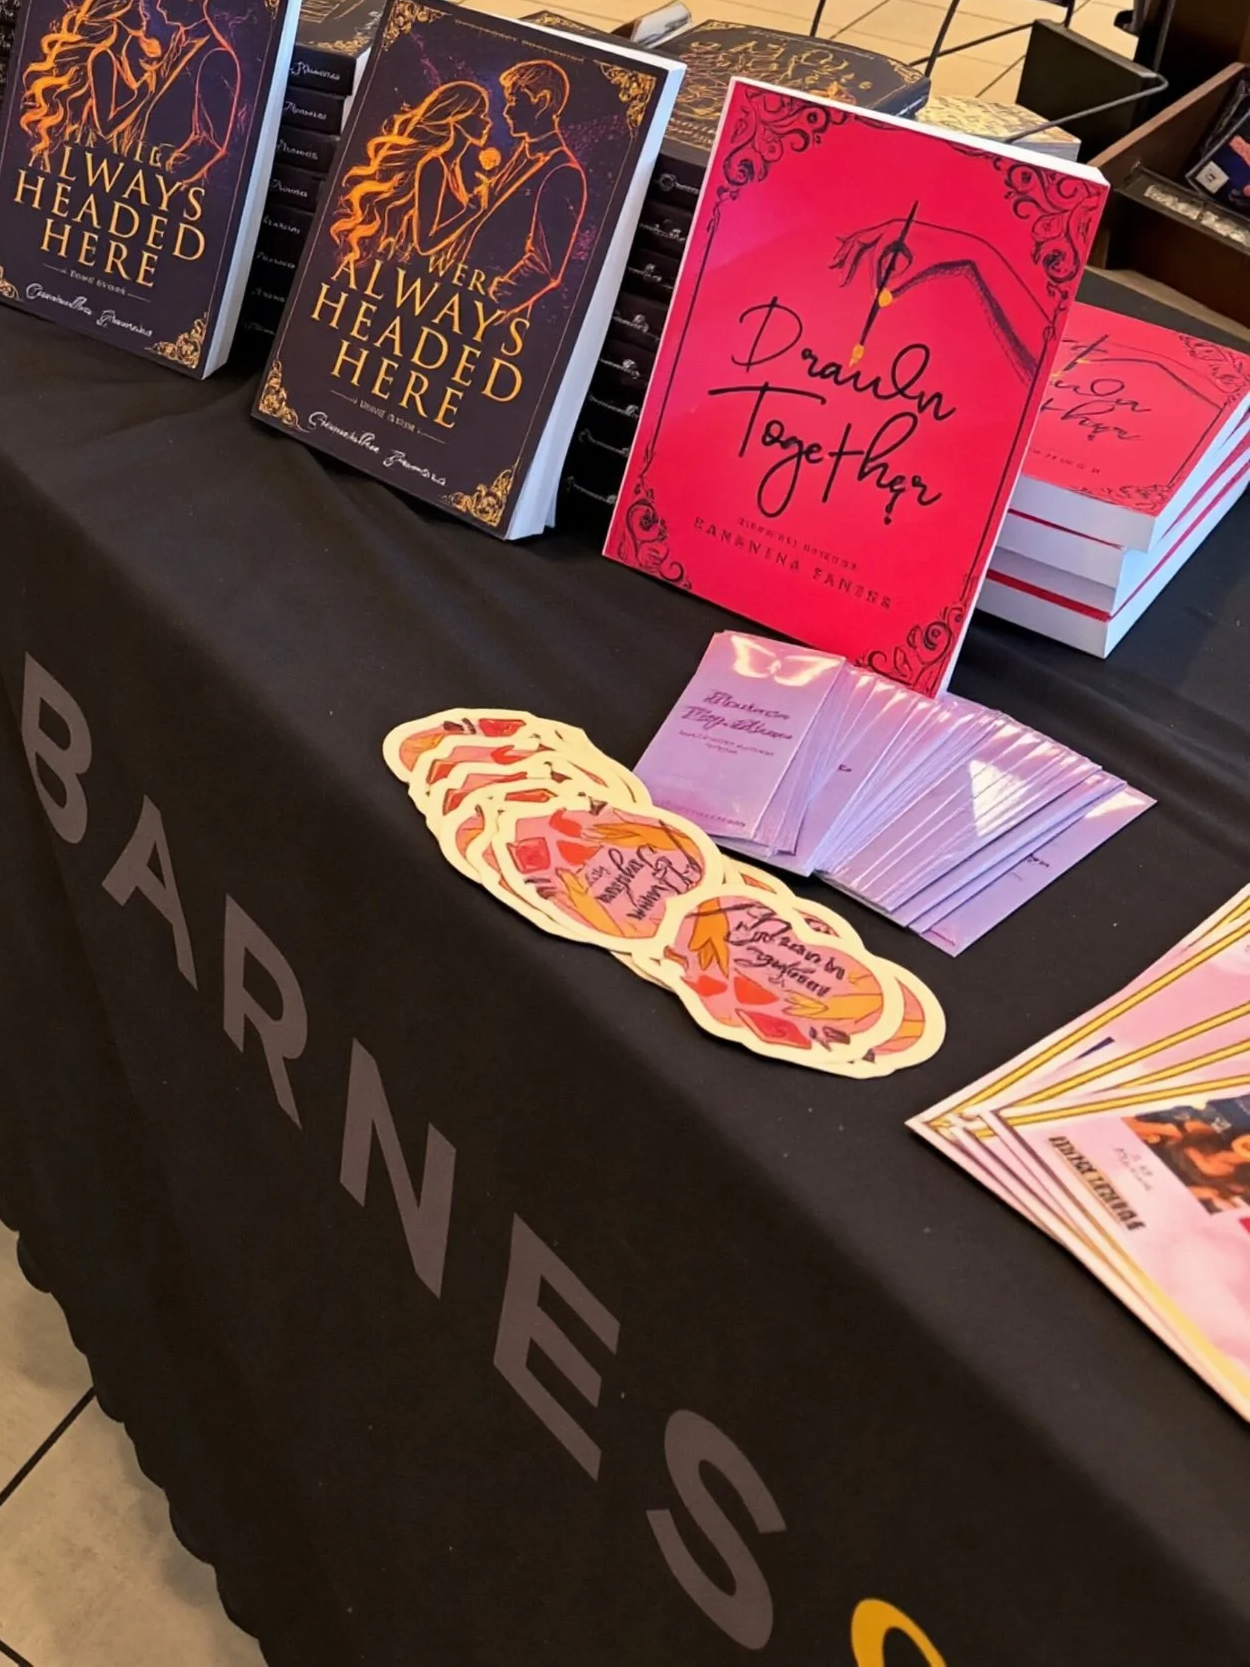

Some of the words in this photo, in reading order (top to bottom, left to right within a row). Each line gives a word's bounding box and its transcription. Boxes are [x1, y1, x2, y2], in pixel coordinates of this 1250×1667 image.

[14, 169, 206, 261] HEADED
[27, 141, 207, 221] ALWAYS
[40, 219, 157, 288] HERE
[310, 283, 523, 403] HEADED
[330, 252, 531, 358] ALWAYS
[329, 339, 465, 430] HERE
[707, 381, 943, 526] Together
[21, 652, 787, 1651] BARNES
